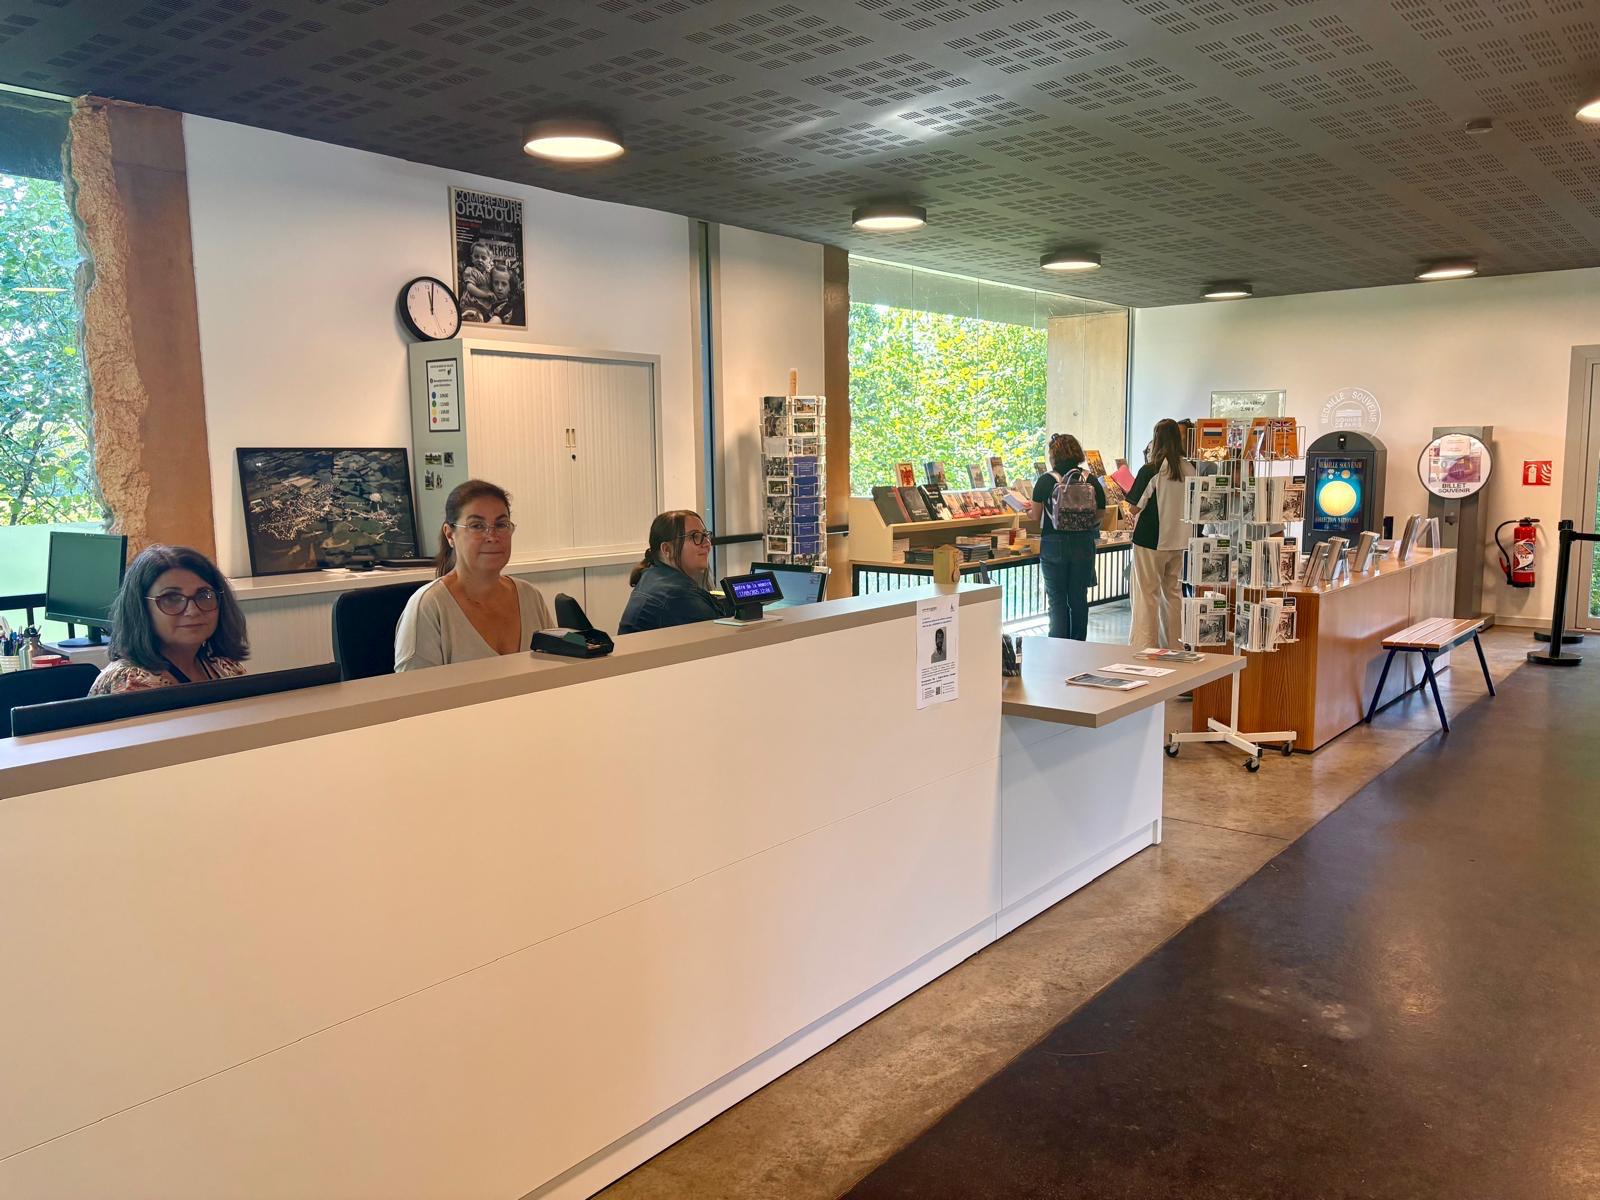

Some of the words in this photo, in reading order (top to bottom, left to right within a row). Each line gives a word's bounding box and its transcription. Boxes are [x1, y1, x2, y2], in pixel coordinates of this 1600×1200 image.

[456, 191, 522, 211] COMPRENDRE
[456, 201, 522, 224] ORADOUR
[1352, 391, 1377, 423] SOUVENIR
